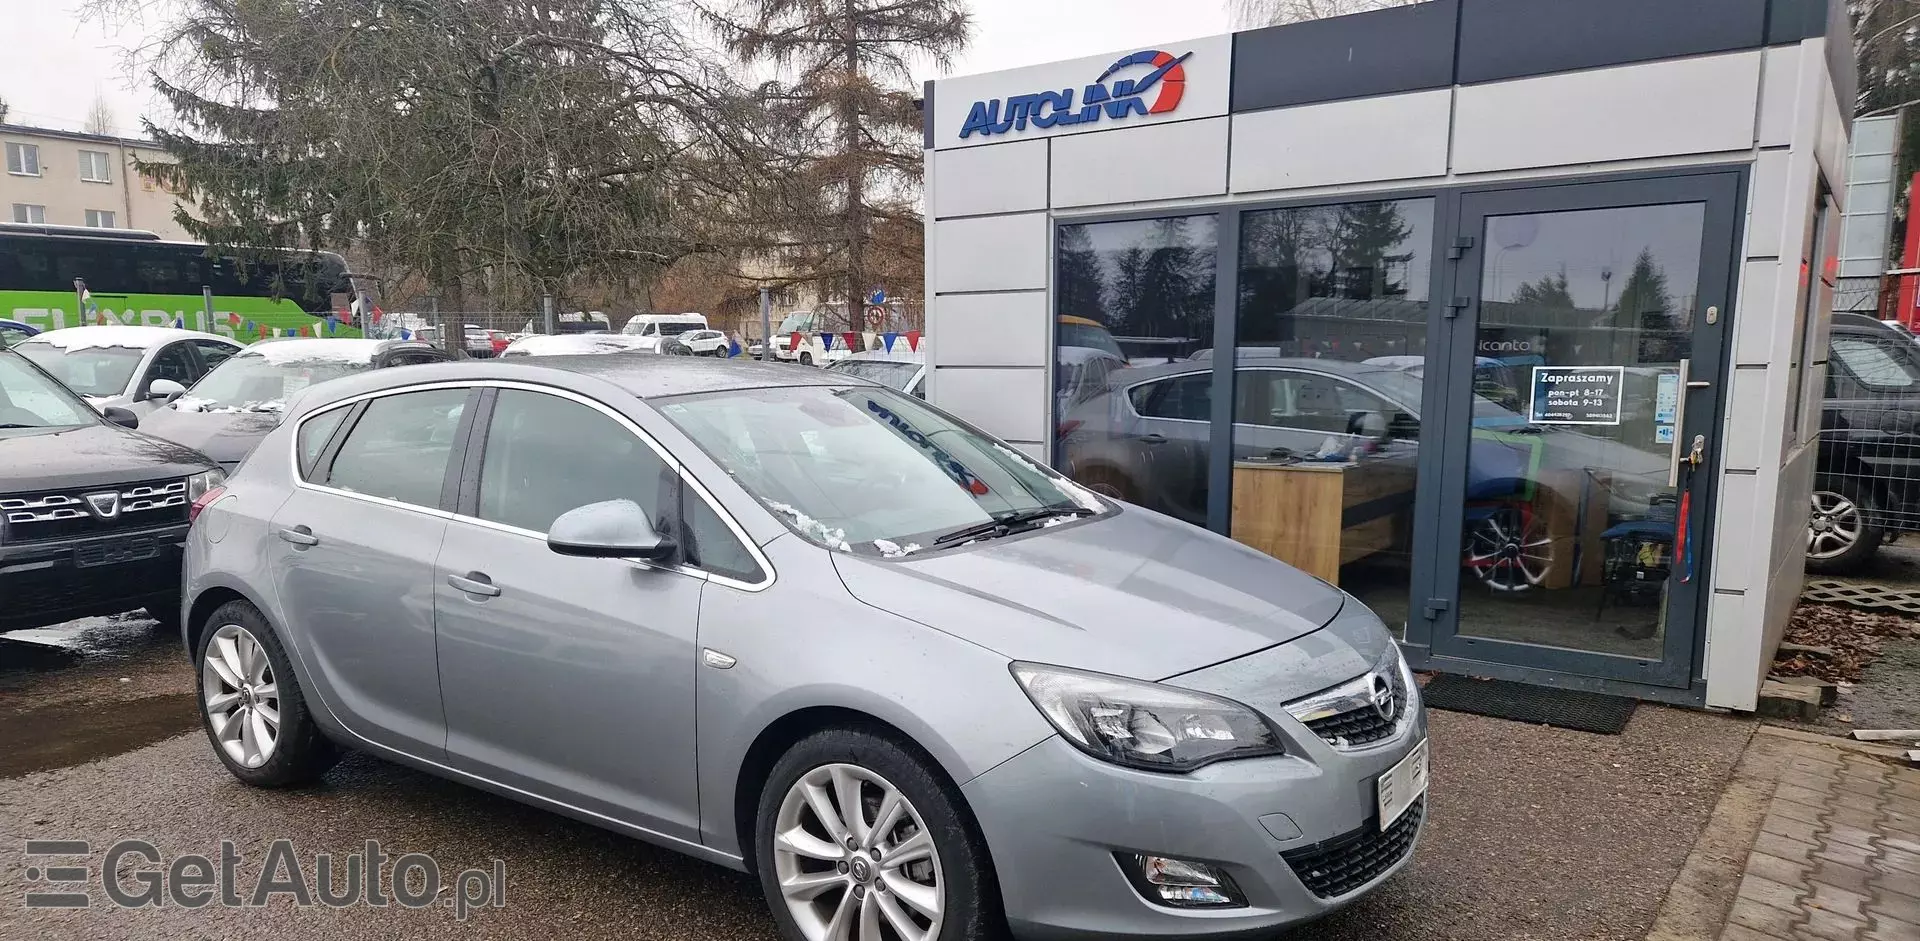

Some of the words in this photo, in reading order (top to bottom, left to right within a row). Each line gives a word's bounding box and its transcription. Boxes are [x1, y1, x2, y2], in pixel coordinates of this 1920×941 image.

[959, 79, 1151, 138] AUTOLINK
[1541, 372, 1613, 385] Zapraszamy
[1548, 389, 1579, 398] pon-pt
[1583, 388, 1604, 397] 8-17
[1548, 399, 1578, 407] sobota
[1582, 398, 1603, 407] 9-13
